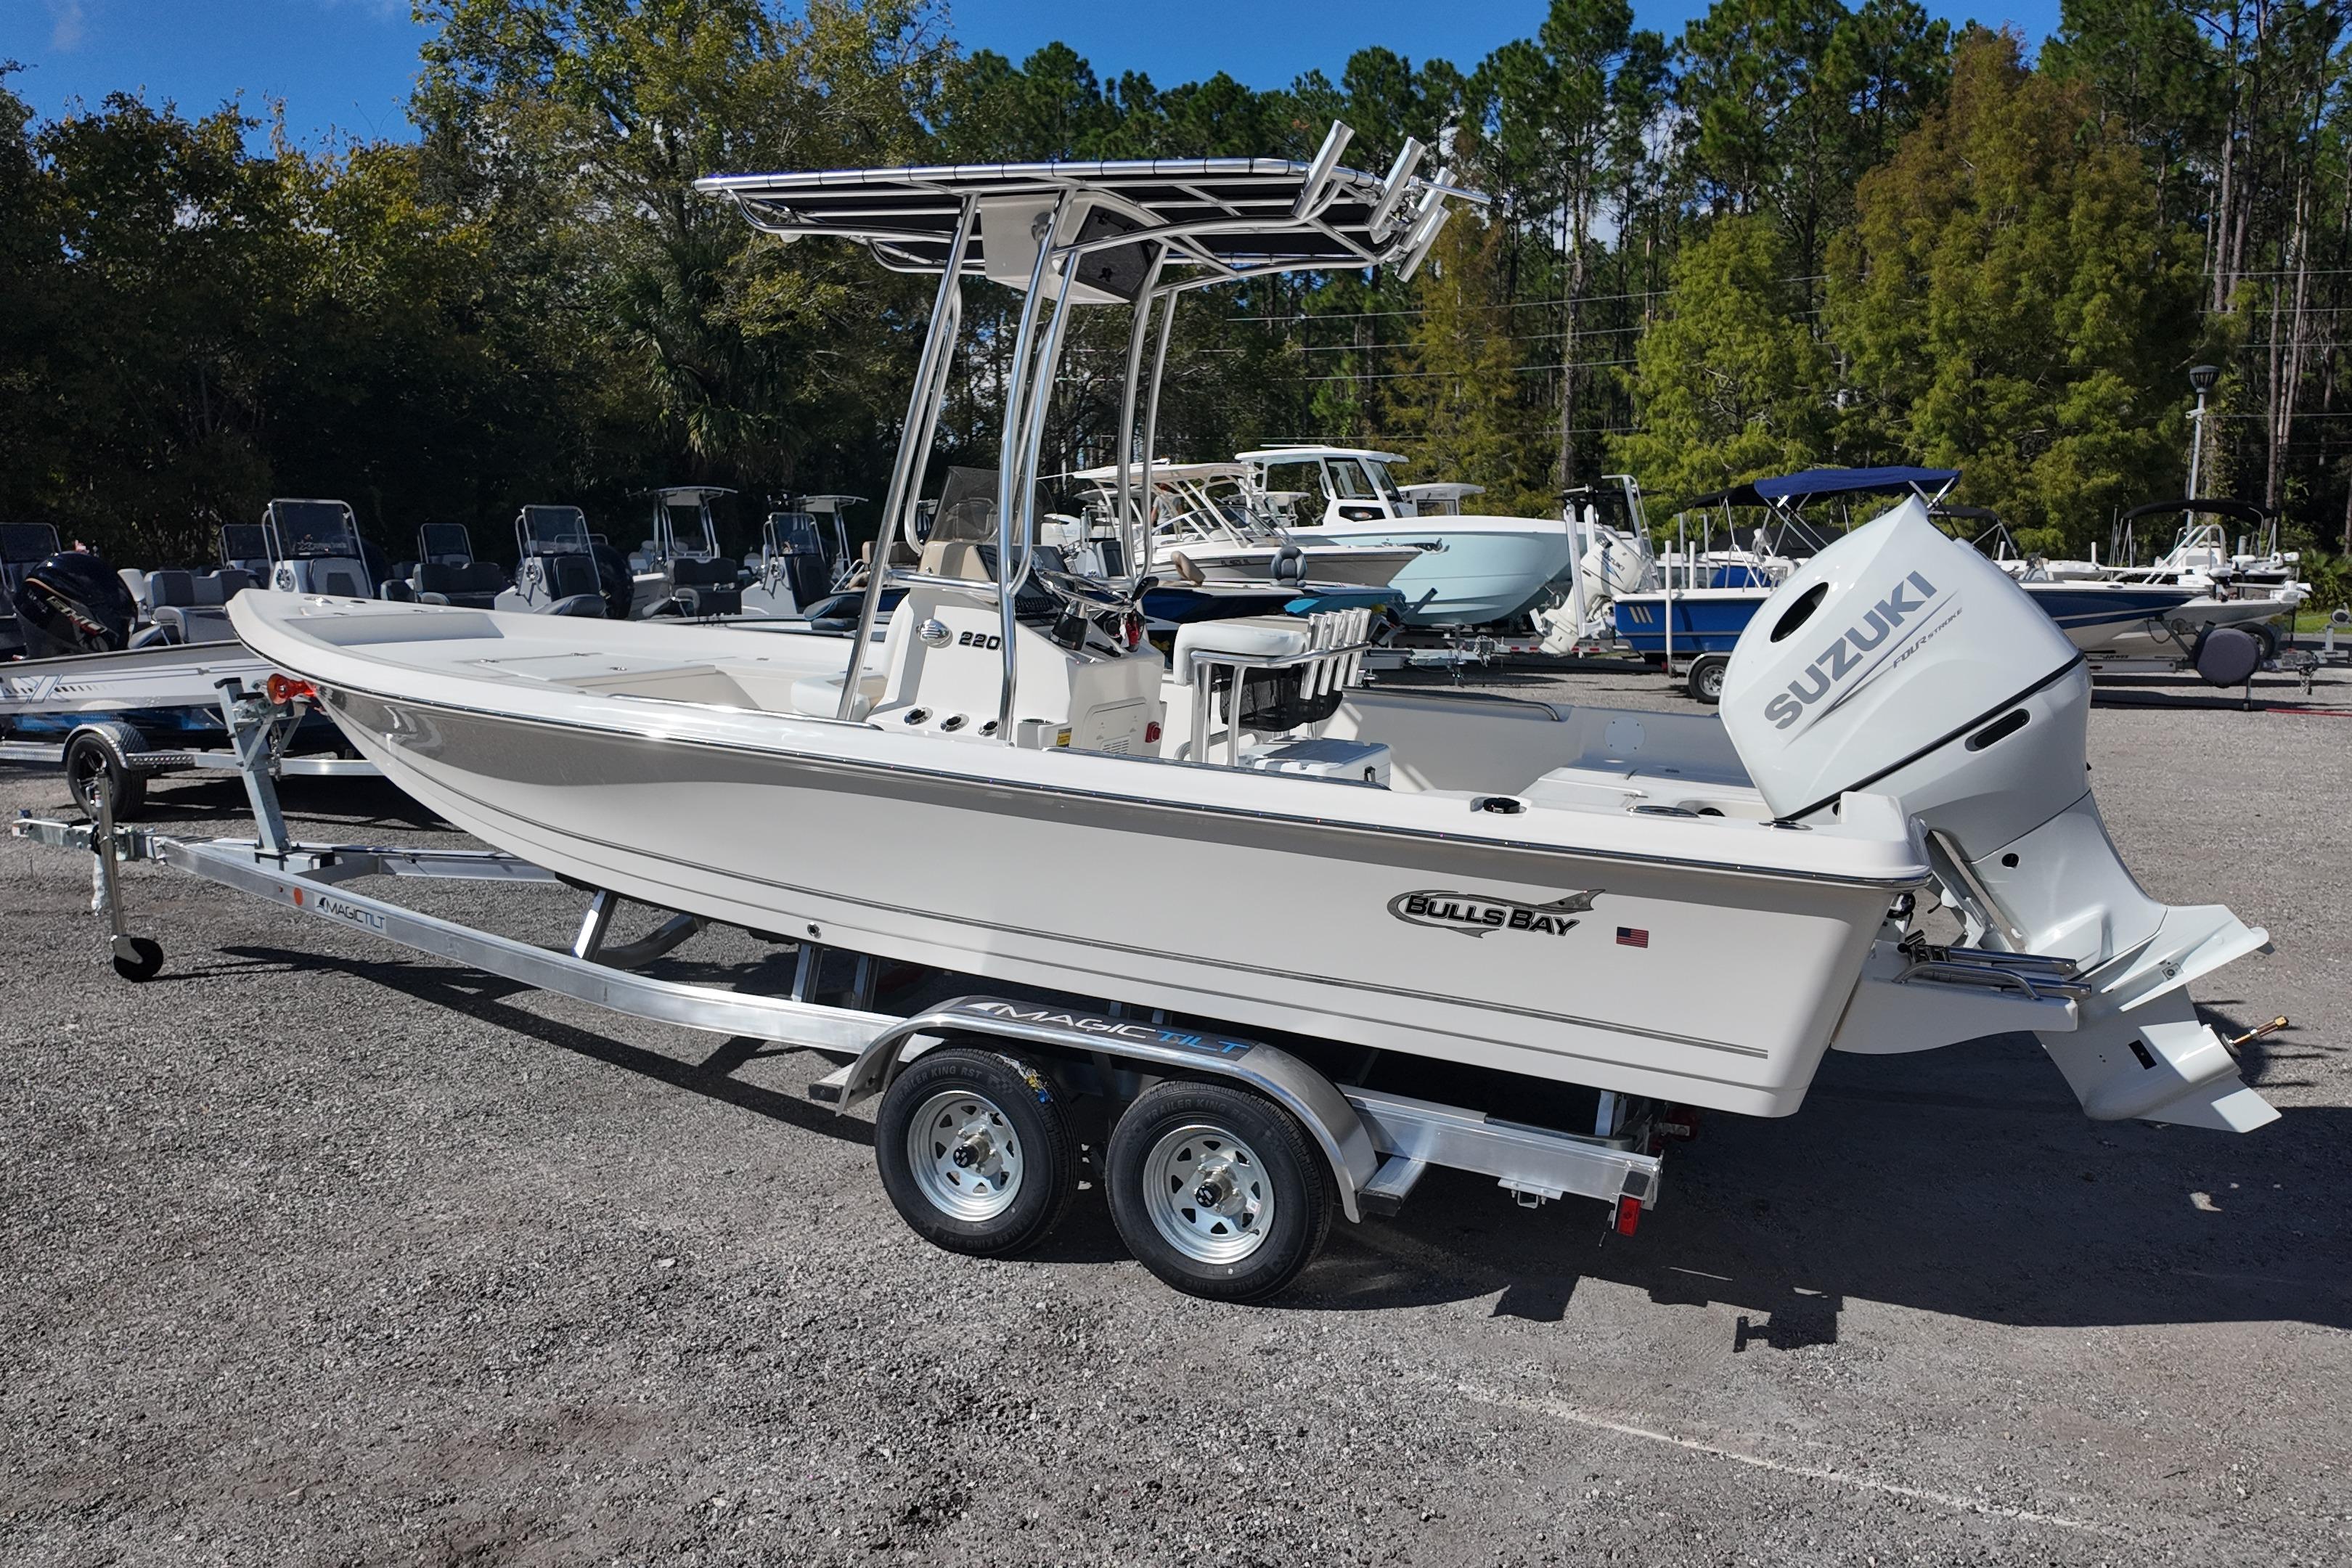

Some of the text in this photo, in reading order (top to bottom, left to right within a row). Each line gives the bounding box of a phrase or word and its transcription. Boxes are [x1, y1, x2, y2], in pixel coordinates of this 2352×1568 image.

[957, 630, 1002, 651] 220
[1764, 570, 1937, 730] SUZUKI
[1893, 635, 1927, 669] FOUR
[1405, 894, 1580, 936] BULLS BAY
[931, 1065, 957, 1079] KING
[960, 1066, 982, 1079] RST
[1145, 1098, 1193, 1123] TRAILER
[1198, 1098, 1228, 1112] KING
